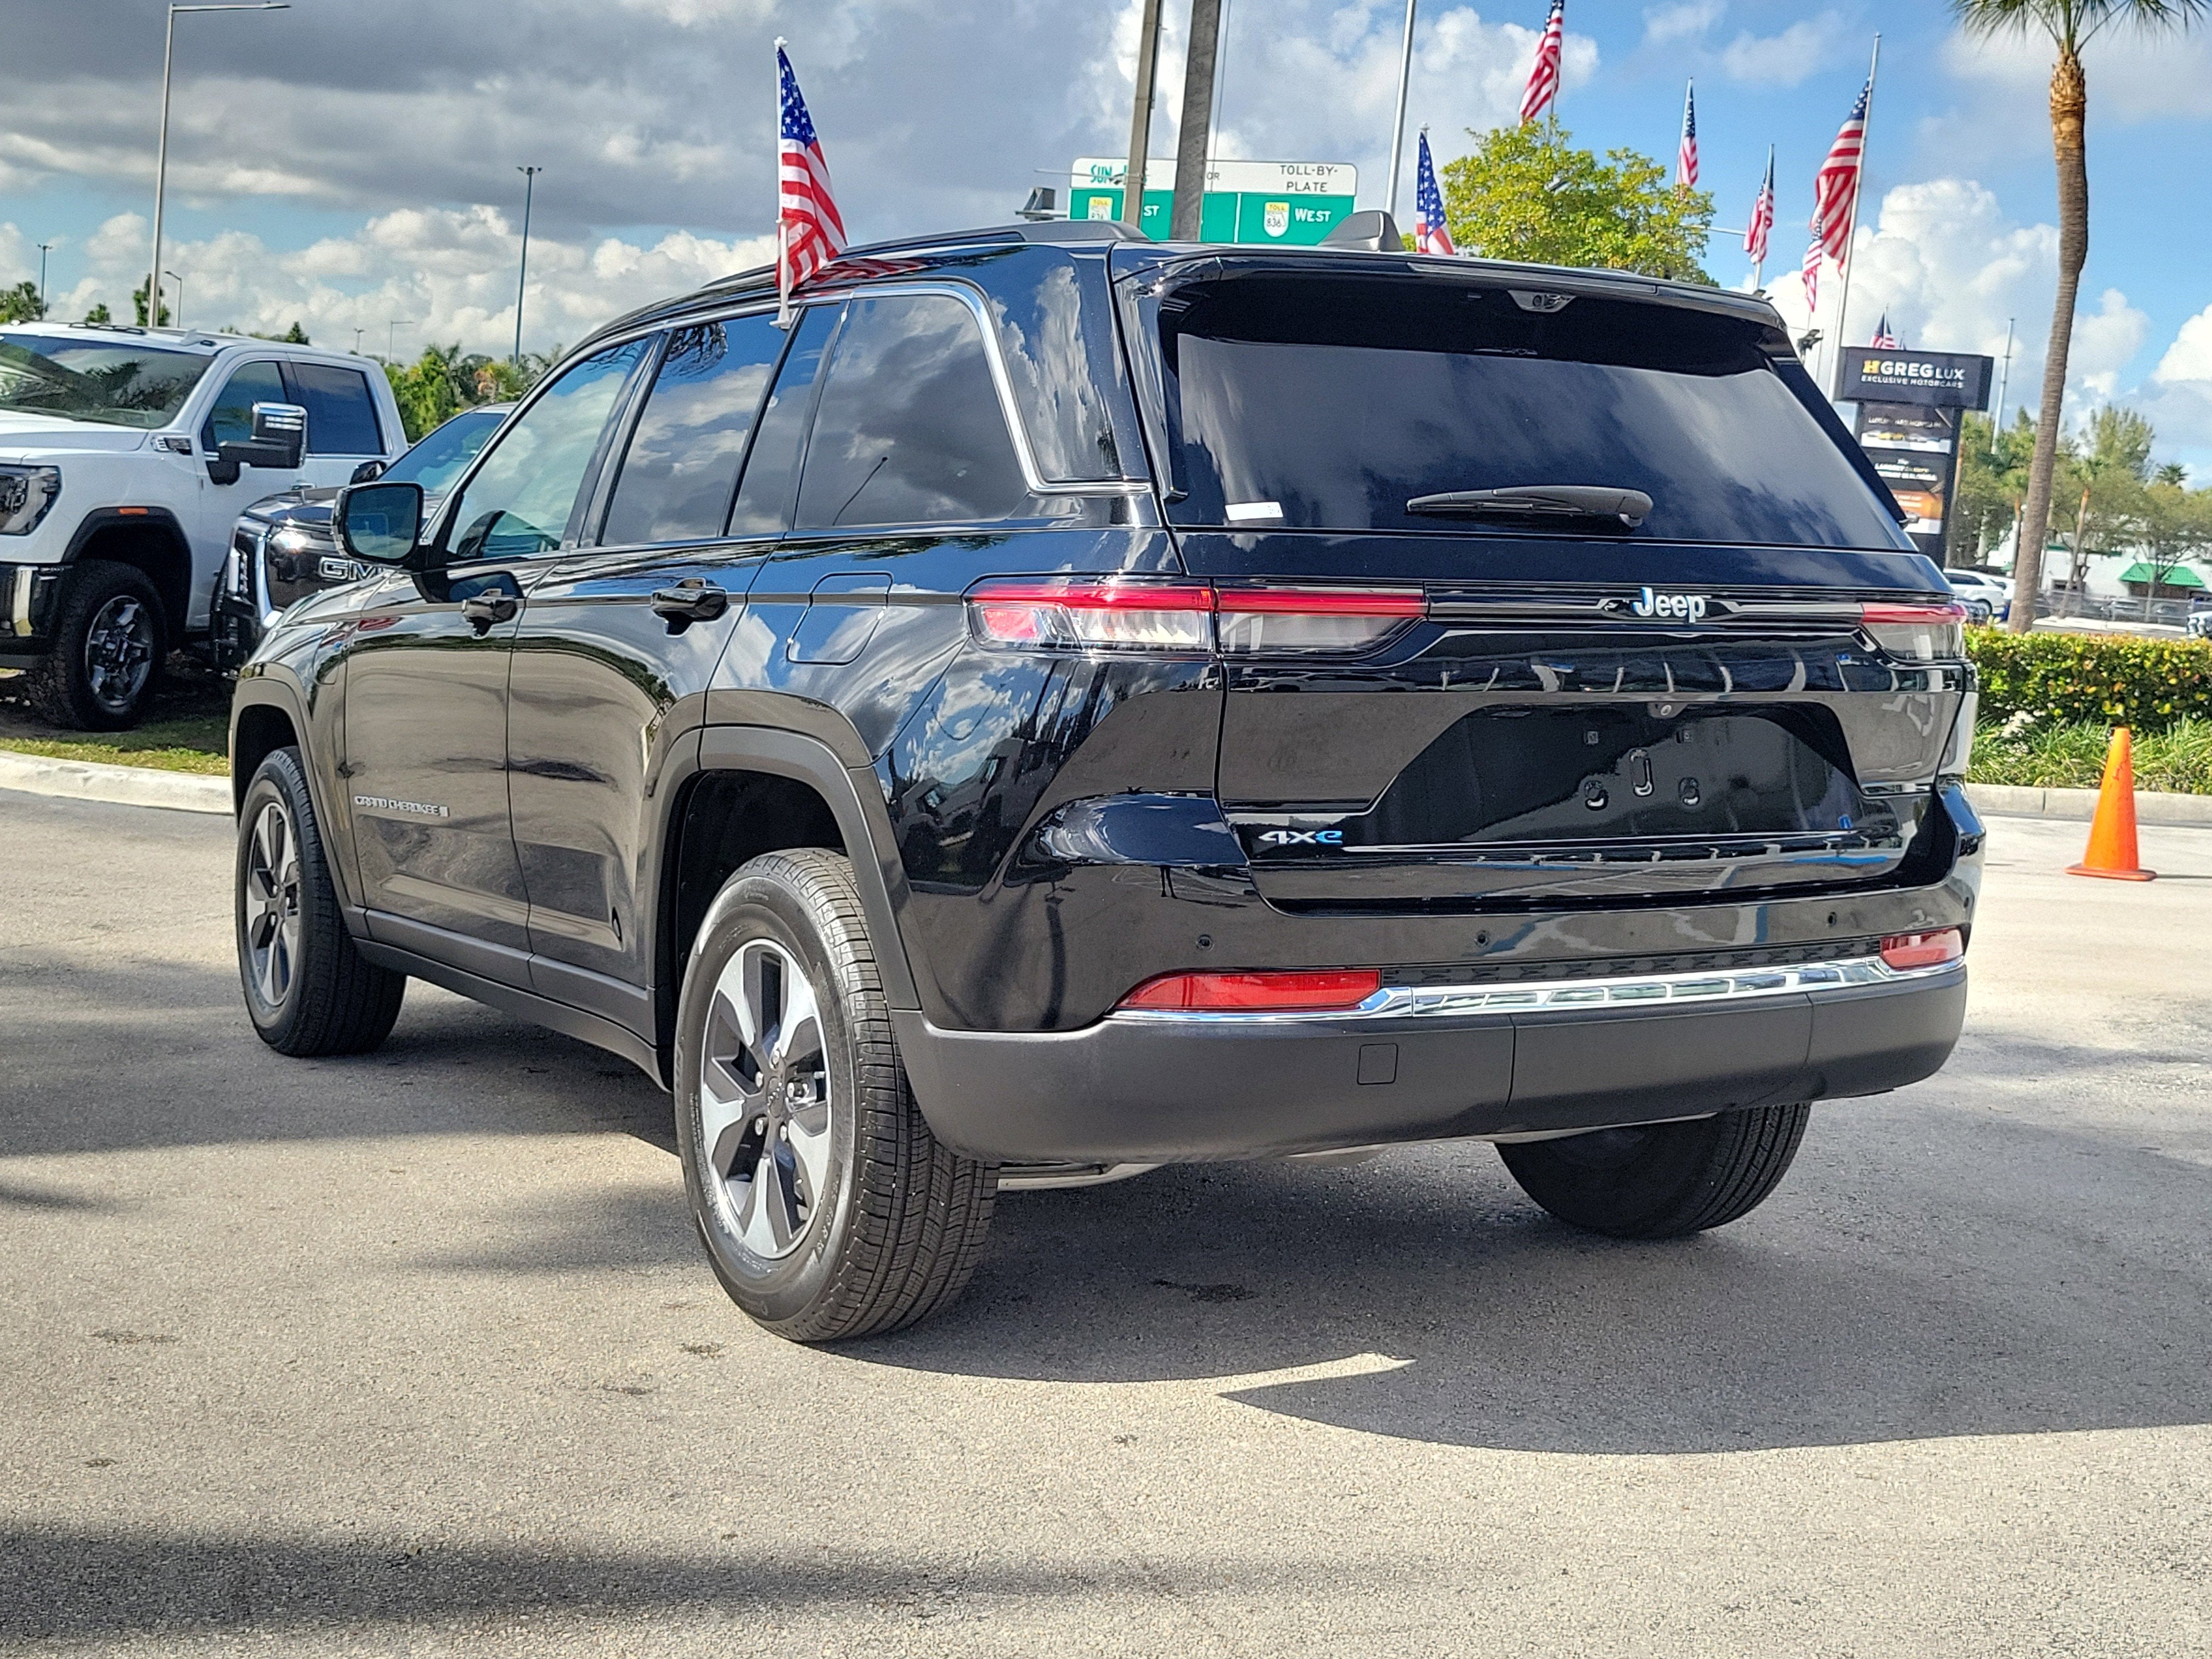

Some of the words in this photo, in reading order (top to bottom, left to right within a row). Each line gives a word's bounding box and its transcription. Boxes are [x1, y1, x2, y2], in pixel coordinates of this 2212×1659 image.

[1286, 182, 1328, 193] PLATE
[1295, 208, 1331, 222] WEST
[1861, 375, 1908, 385] EXCLUSIVE
[1910, 379, 1964, 389] MOTORCARS
[319, 556, 382, 580] GM
[1632, 587, 1706, 623] Jeep
